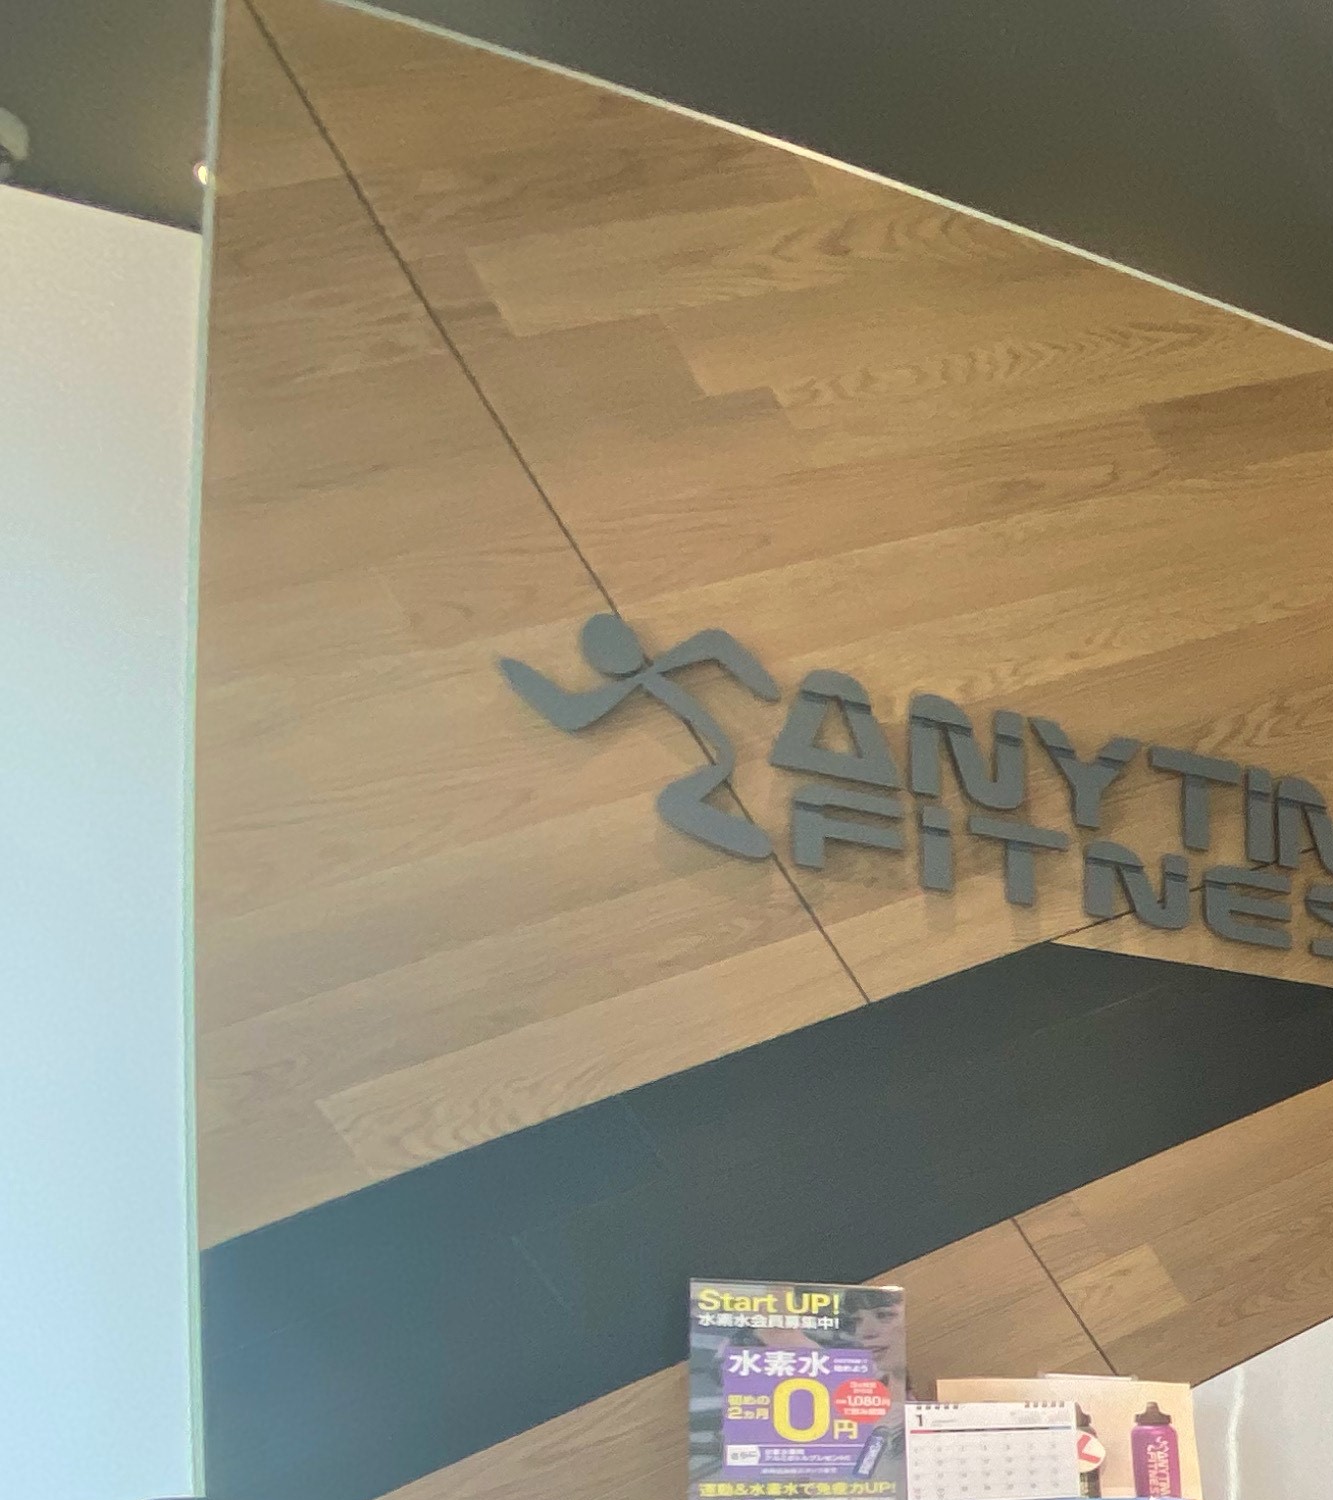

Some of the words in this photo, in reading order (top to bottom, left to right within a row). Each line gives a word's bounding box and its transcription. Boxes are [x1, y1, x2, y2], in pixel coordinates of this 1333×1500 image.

[698, 1287, 778, 1313] Start
[785, 1291, 840, 1315] UP!
[728, 1350, 831, 1377] 水素水
[772, 1377, 831, 1443] 0
[915, 1414, 924, 1427] 1
[833, 1419, 859, 1440] 円
[1157, 1450, 1171, 1496] ANYTIM
